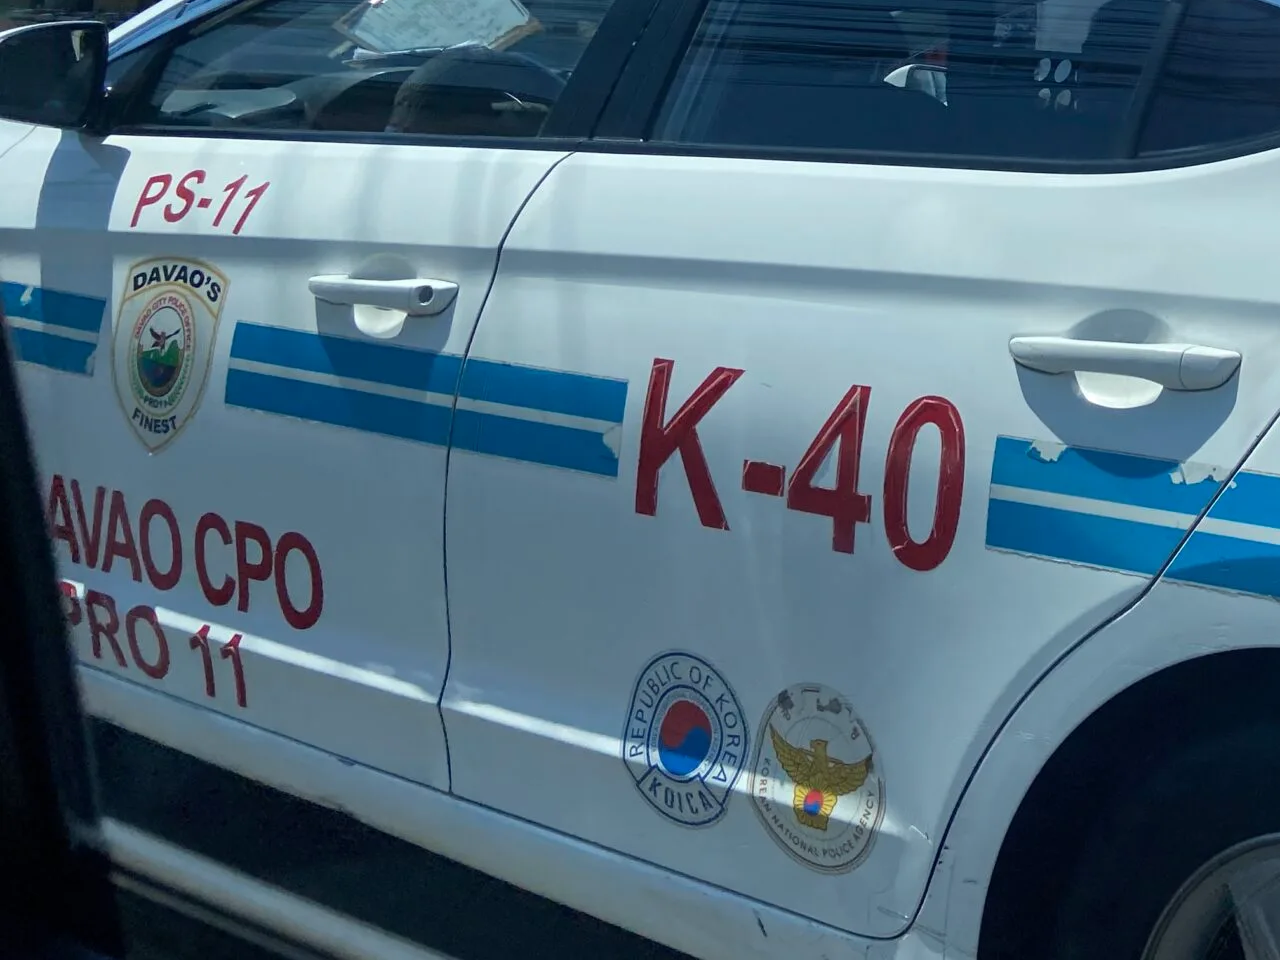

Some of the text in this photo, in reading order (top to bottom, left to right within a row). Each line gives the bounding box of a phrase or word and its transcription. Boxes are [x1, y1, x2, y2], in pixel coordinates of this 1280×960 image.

[130, 169, 270, 235] PS-11
[133, 264, 222, 302] DAVAO'S
[152, 296, 167, 312] CITY
[168, 295, 188, 318] POLICE
[132, 407, 178, 434] FINEST
[635, 358, 966, 572] K-40
[50, 473, 324, 630] AVAO CPO
[189, 624, 248, 708] 11
[629, 661, 682, 758] REPUBLIC
[689, 665, 714, 691] OF
[712, 692, 741, 784] KOREA
[648, 776, 714, 815] KOICA
[758, 757, 876, 859] KOREAN NATIONAL POLICE AGENCY
